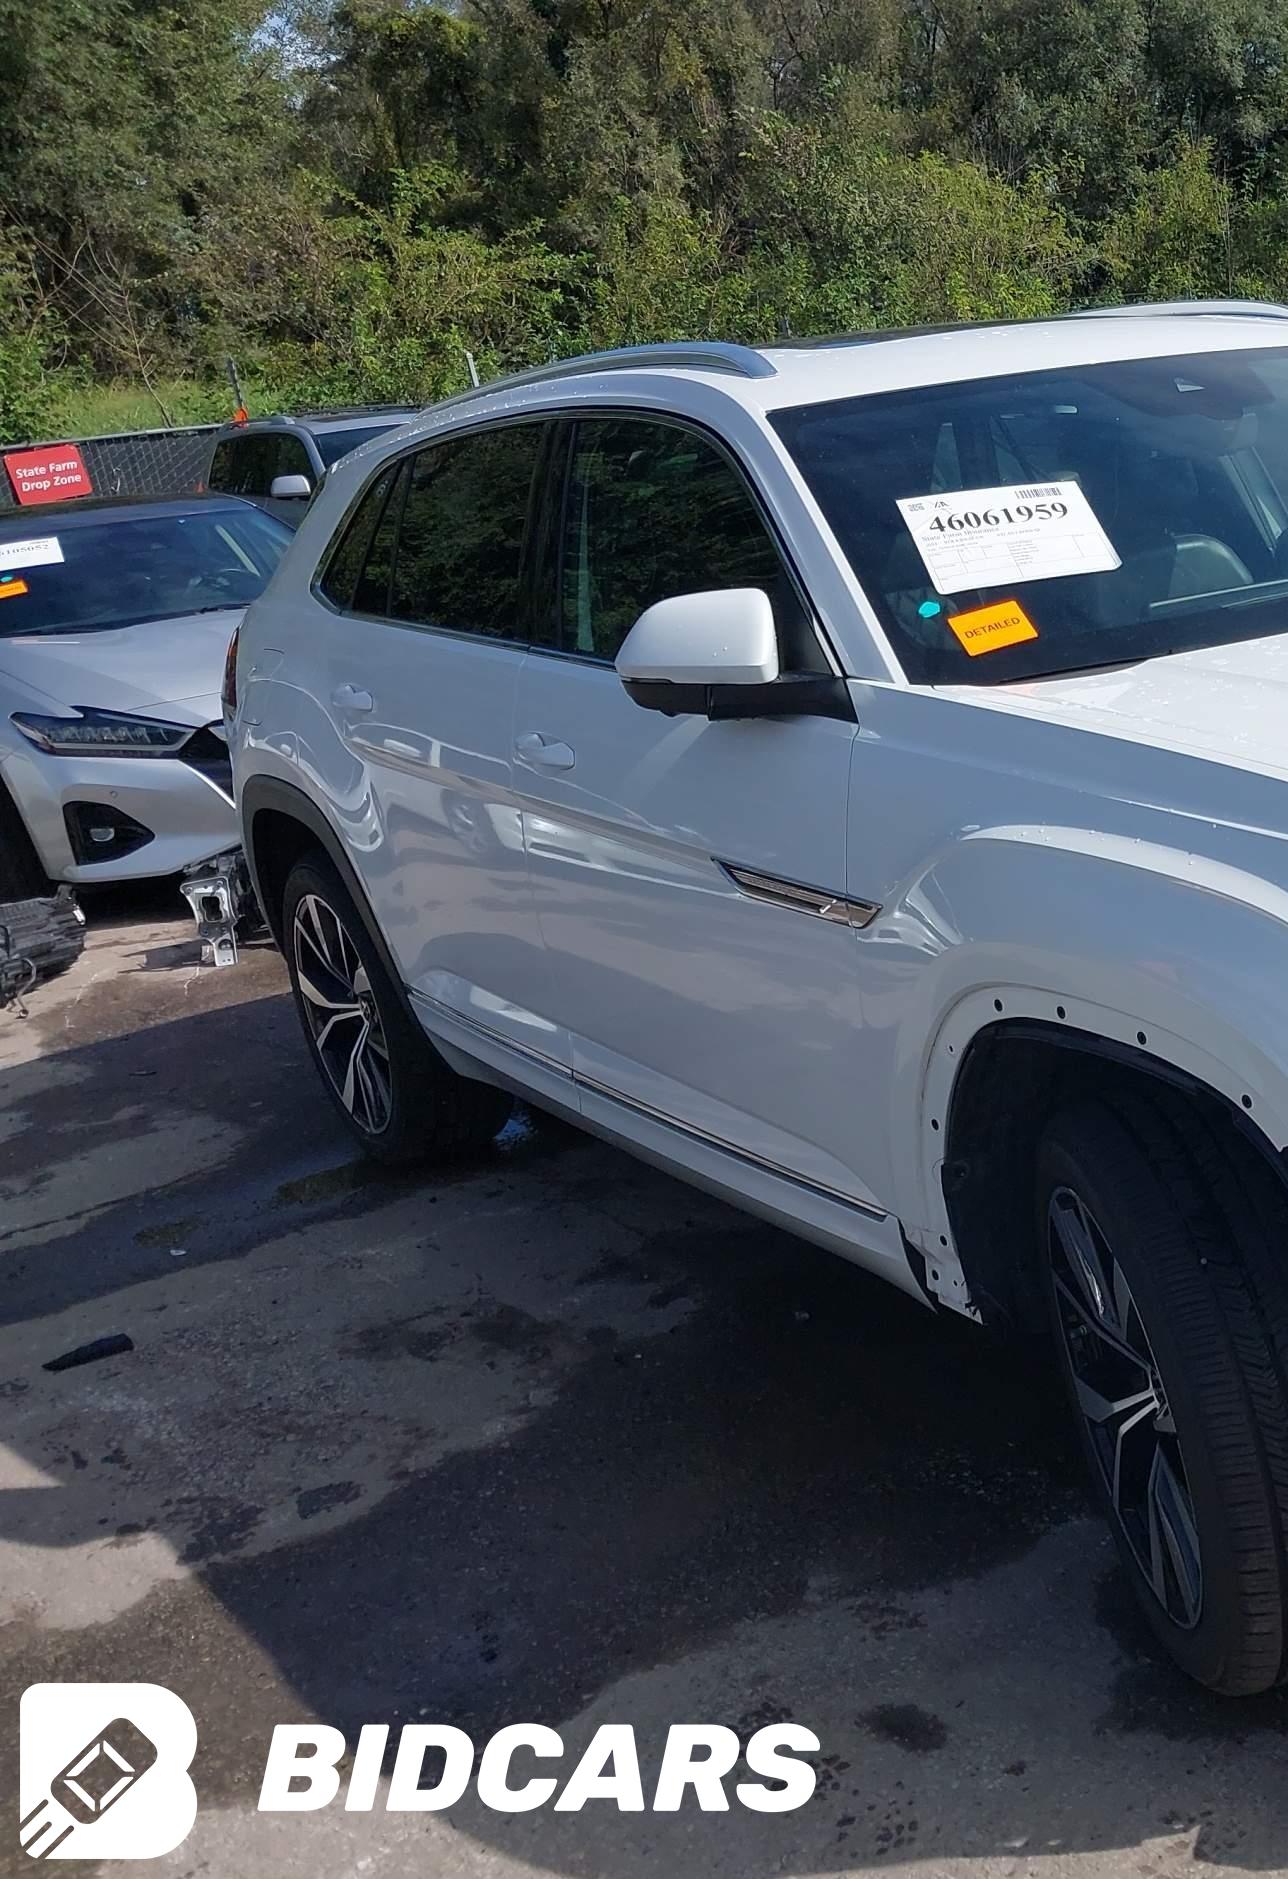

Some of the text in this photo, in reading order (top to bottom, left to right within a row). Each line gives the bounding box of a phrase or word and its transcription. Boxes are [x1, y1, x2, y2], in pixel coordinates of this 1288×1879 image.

[16, 461, 78, 479] State Farm
[21, 474, 82, 492] Drop Zone
[929, 501, 1068, 532] 46061959
[964, 616, 1021, 639] DETAILED
